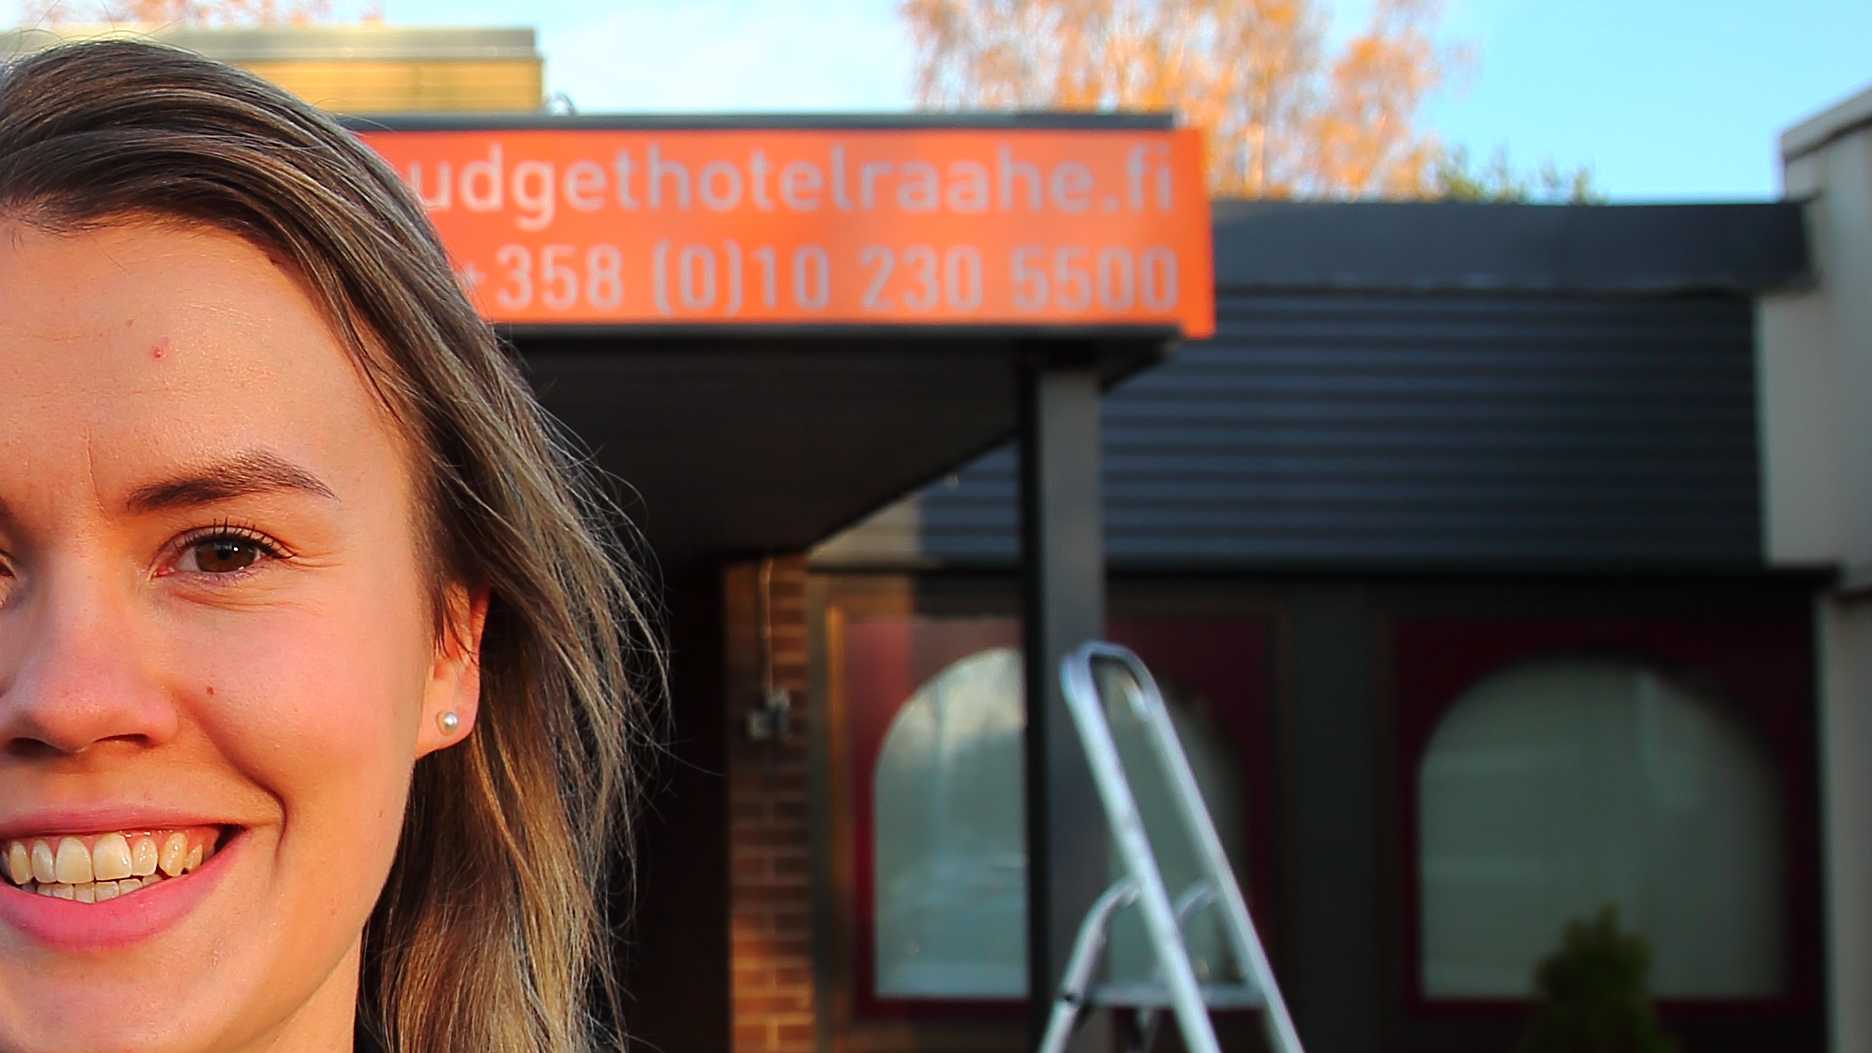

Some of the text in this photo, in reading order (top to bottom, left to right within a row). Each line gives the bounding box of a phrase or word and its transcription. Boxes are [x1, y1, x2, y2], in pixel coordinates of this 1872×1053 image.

[406, 142, 1174, 231] udgethotelraahe.fi
[654, 237, 830, 318] (0)10
[859, 243, 985, 313] 230
[1011, 243, 1179, 314] 5500
